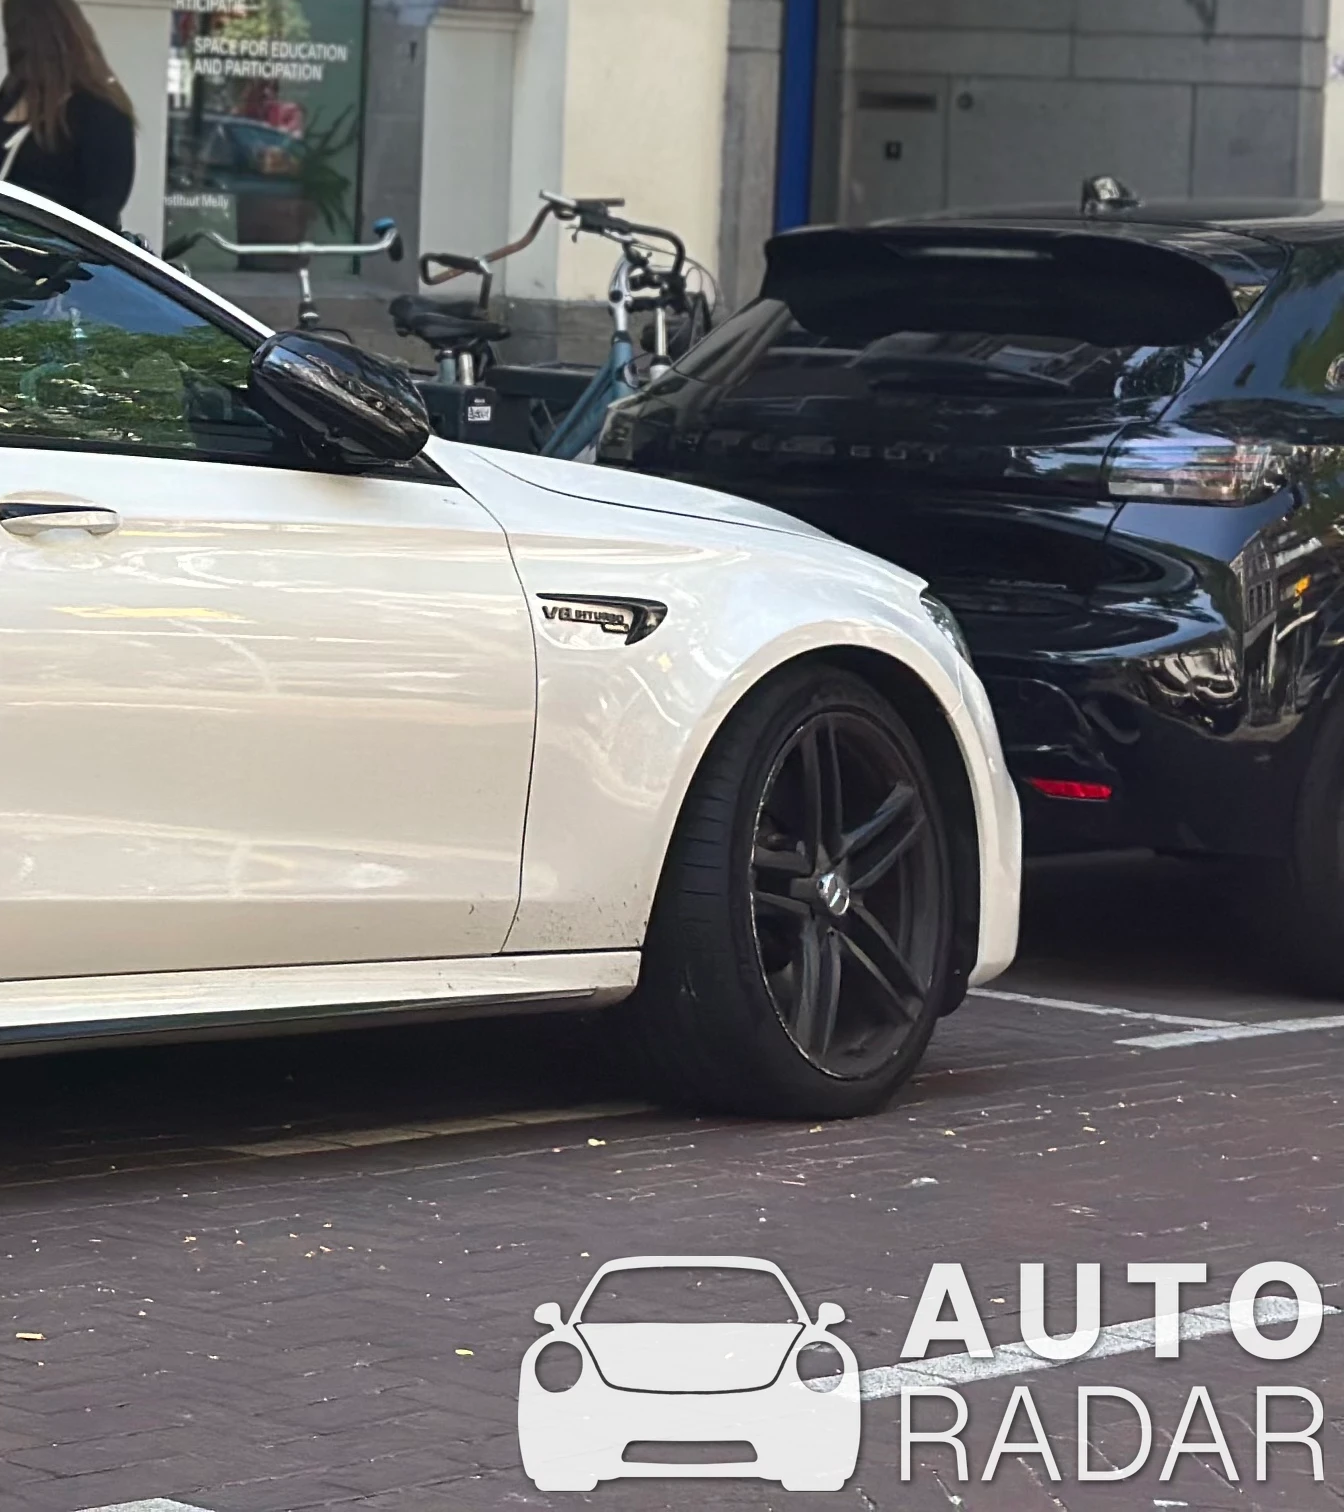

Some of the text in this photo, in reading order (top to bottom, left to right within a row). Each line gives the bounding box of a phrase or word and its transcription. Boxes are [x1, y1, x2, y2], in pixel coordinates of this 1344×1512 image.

[194, 37, 348, 62] SPACE FOR EDUCATION
[194, 59, 324, 82] AND PARTICIPATION
[162, 192, 199, 206] nstituut
